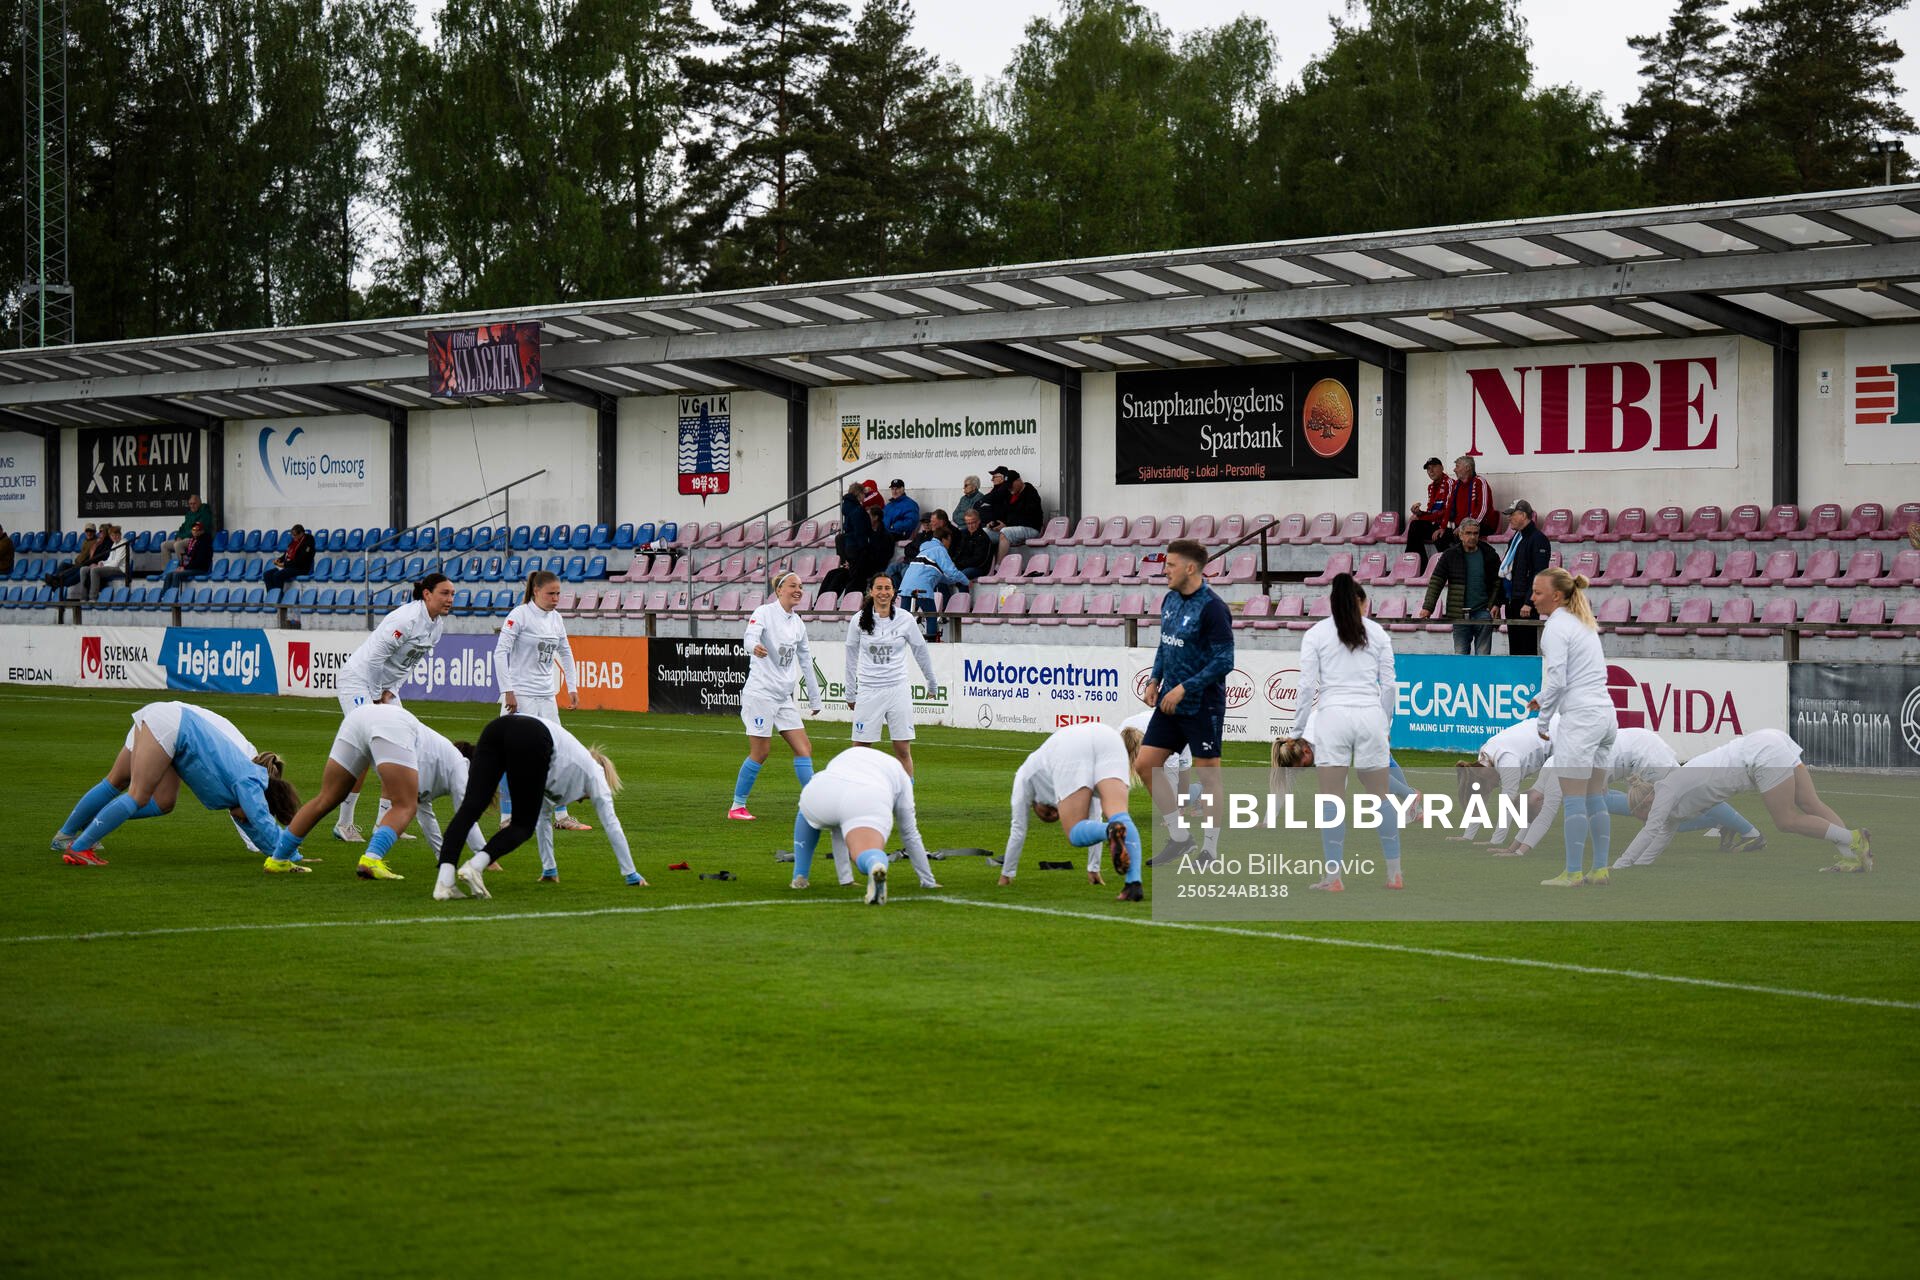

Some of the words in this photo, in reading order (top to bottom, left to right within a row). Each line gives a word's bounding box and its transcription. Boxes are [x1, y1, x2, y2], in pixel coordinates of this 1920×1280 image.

[453, 343, 521, 393] KLACKEN
[1820, 385, 1829, 394] C2
[1122, 387, 1284, 425] Snapphanebygdens
[1465, 357, 1718, 457] NIBE
[867, 417, 962, 440] Hässleholms
[965, 416, 1037, 437] kommun
[112, 432, 192, 467] KREATIV
[1200, 423, 1284, 458] Sparbank
[893, 449, 925, 459] människor
[935, 449, 944, 458] att
[987, 446, 1008, 457] arbeta
[1009, 444, 1020, 456] och
[282, 455, 317, 480] Vittsjö
[320, 454, 365, 480] Omsorg
[1138, 465, 1189, 482] Självständig
[1196, 463, 1218, 478] Lokal
[1225, 463, 1266, 479] Personlig
[112, 473, 189, 494] REKLAM
[104, 646, 148, 661] SVENSKA
[313, 651, 351, 669] SVENS
[676, 643, 684, 655] Vi
[685, 643, 703, 658] gillar
[704, 643, 732, 656] fotboll.
[105, 665, 127, 680] SPEL
[177, 640, 219, 683] Heja
[222, 643, 261, 686] dig!
[407, 648, 446, 693] eja
[450, 648, 492, 687] alla!
[8, 667, 52, 681] ERIDAN
[658, 663, 746, 688] Snapphanebygdens
[964, 659, 1118, 688] Motorcentrum
[968, 686, 1013, 700] Markaryd
[1016, 688, 1029, 699] AB
[1051, 689, 1075, 700] 0433
[1085, 690, 1103, 701] 756
[1105, 691, 1118, 702] 00
[825, 703, 850, 711] KRISTIAN
[1640, 681, 1743, 736] VIDA
[996, 714, 1037, 724] Mercedes-Benz
[1409, 723, 1438, 733] MAKING
[1440, 723, 1454, 733] LIFT
[1456, 724, 1484, 734] TRUCKS
[1798, 712, 1828, 725] ALLA
[1833, 710, 1849, 725] ÄR
[1853, 713, 1891, 727] OLIKA
